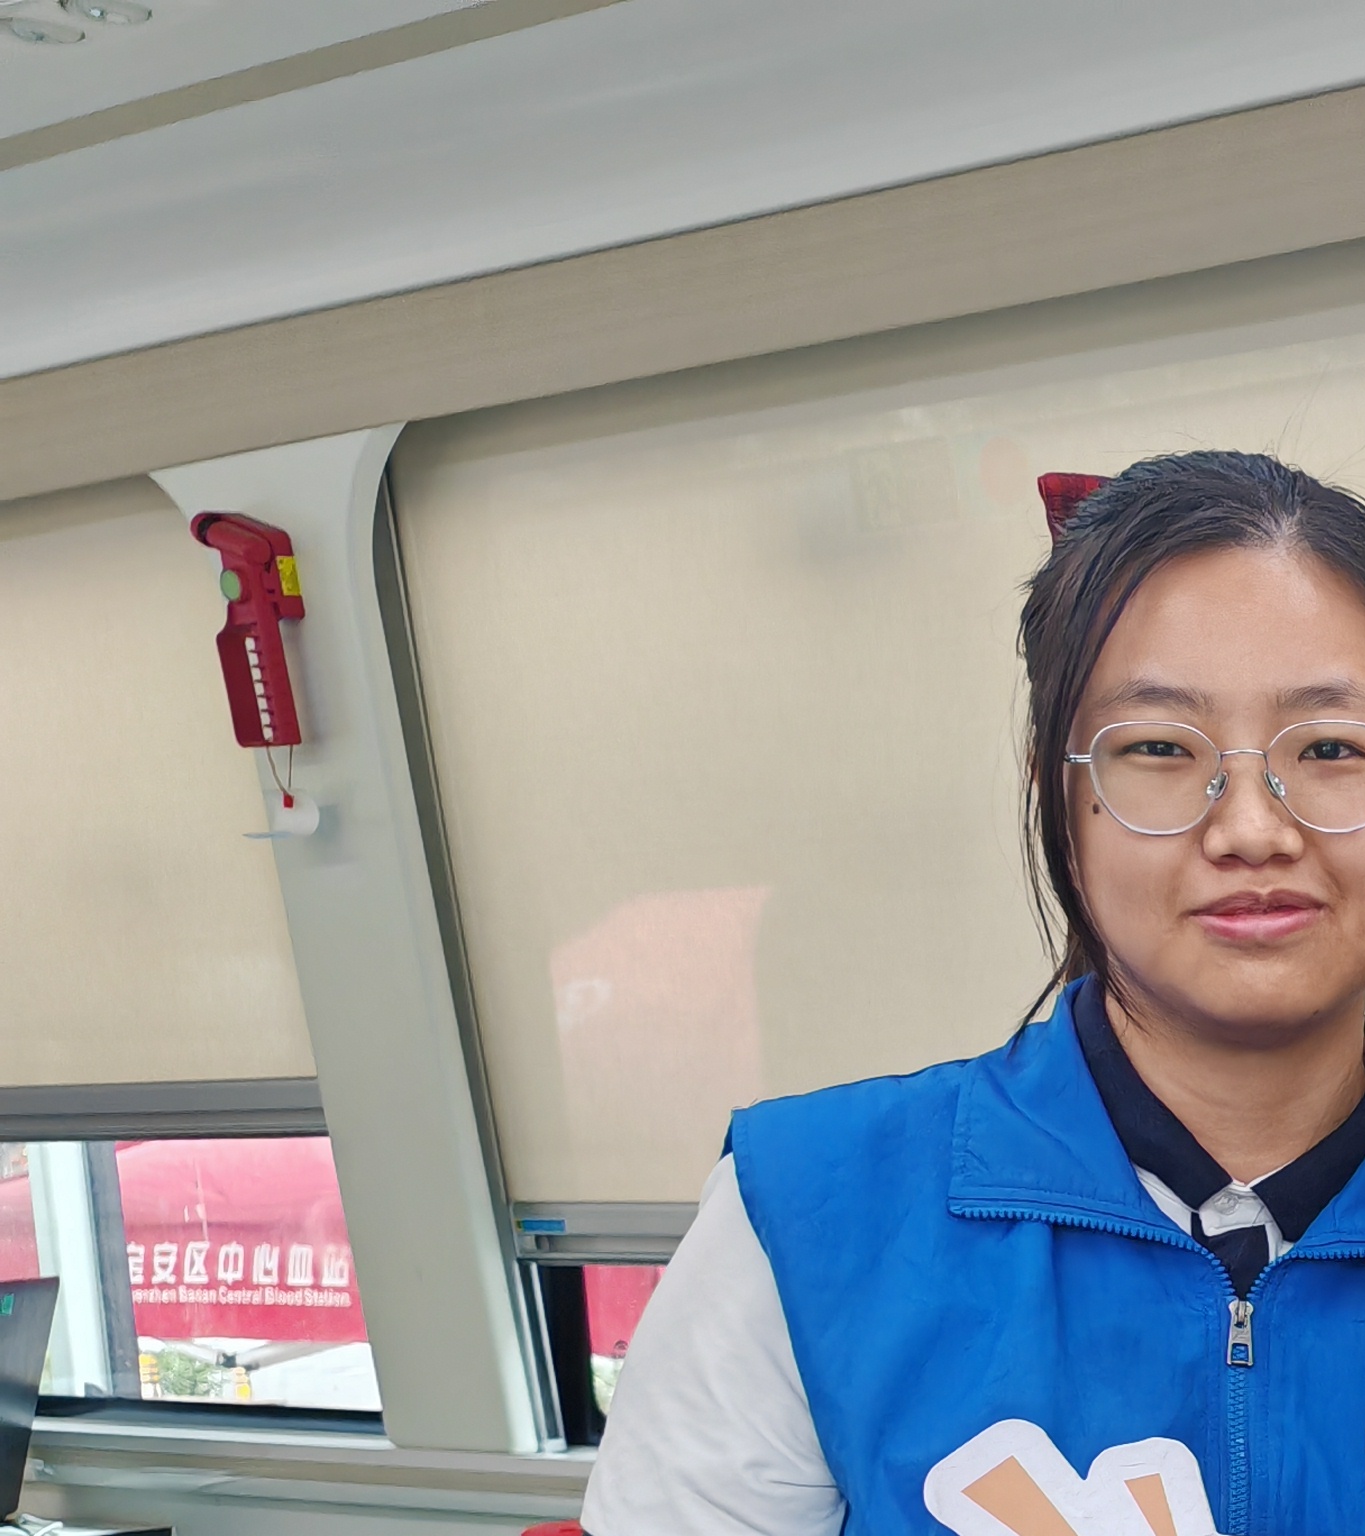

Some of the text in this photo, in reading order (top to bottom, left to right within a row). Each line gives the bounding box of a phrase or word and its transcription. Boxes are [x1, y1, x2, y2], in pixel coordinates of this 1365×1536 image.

[126, 1241, 350, 1287] 宝安区中心血站
[264, 1286, 303, 1306] Blood
